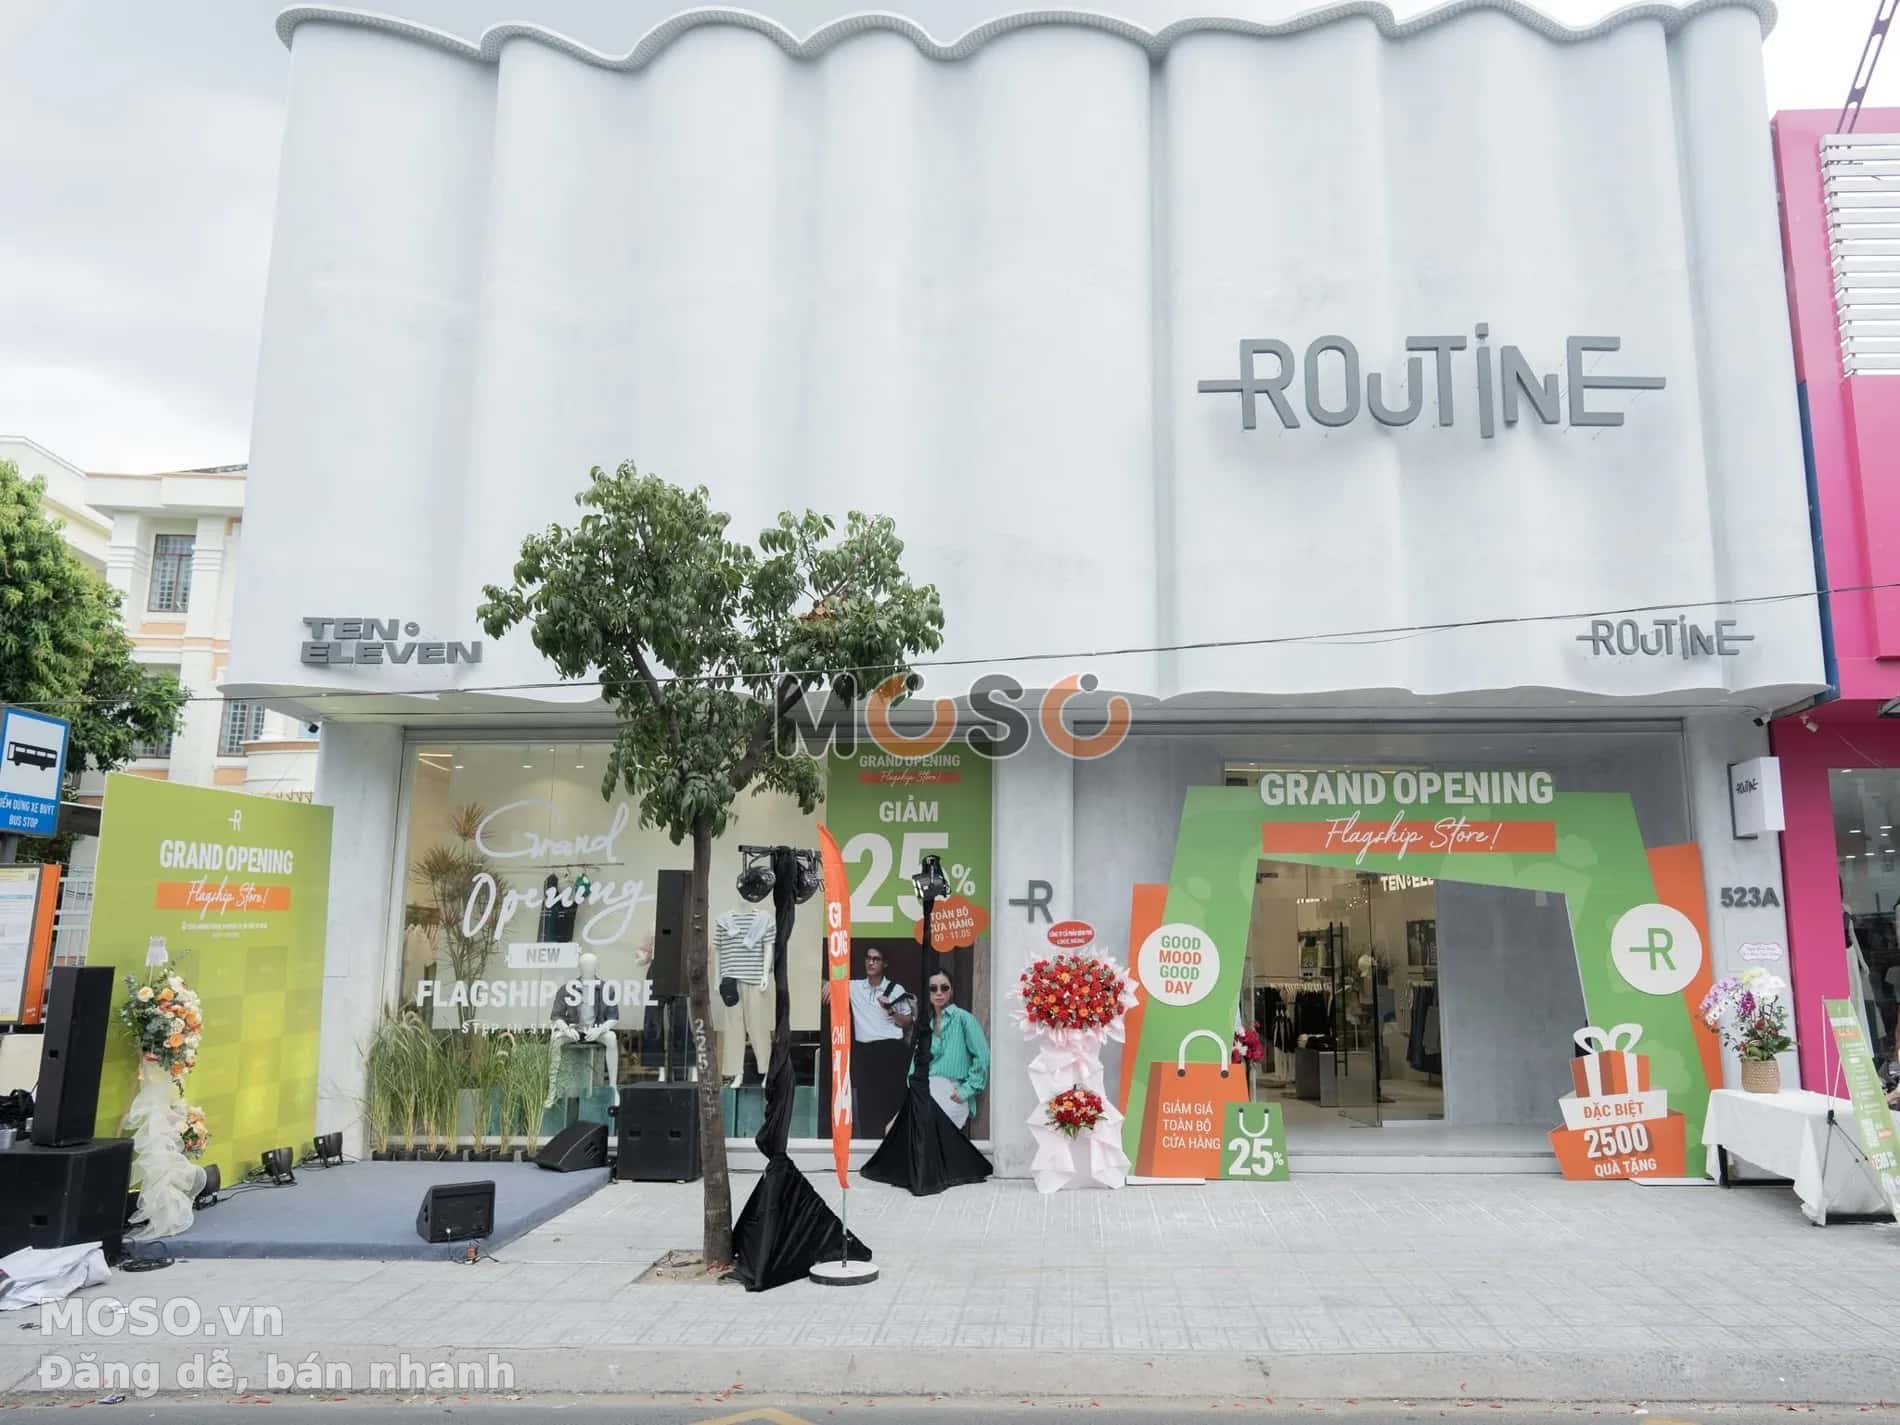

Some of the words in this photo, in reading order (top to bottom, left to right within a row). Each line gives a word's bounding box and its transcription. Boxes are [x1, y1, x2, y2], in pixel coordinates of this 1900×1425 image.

[301, 641, 482, 664] ELEVEN
[860, 755, 903, 768] GRAND
[905, 753, 960, 768] OPENING
[1260, 772, 1386, 806] GRAND
[1393, 771, 1554, 805] OPENING
[879, 795, 939, 823] GIẢM
[9, 814, 21, 827] BUS
[22, 816, 39, 828] STOP
[475, 800, 630, 863] Grand
[1326, 810, 1424, 865] Flagship
[160, 839, 223, 870] GRAND
[226, 844, 294, 875] OPENING
[462, 872, 656, 945] Opening
[1720, 886, 1781, 909] 523A
[1161, 935, 1201, 950] GOOD
[1630, 927, 1677, 971] R
[525, 948, 561, 964] NEW
[1159, 949, 1202, 965] MOOD
[1160, 965, 1200, 980] GOOD
[415, 979, 558, 1008] FLAGSHIP
[564, 979, 659, 1008] STORE
[1165, 980, 1193, 995] DAY
[461, 1022, 500, 1035] STEP
[1162, 1099, 1192, 1115] GIẢM
[1194, 1099, 1213, 1114] GIÁ
[1583, 1102, 1611, 1121] ĐẶC
[1614, 1099, 1644, 1118] BIỆT
[1163, 1117, 1192, 1132] TOÀN
[1196, 1118, 1212, 1134] BỘ
[1162, 1133, 1186, 1149] CỬA
[1188, 1135, 1221, 1150] HÀNG
[1583, 1122, 1649, 1159] 2500
[1228, 1137, 1285, 1177] 25%
[1594, 1159, 1621, 1178] QUÀ
[1622, 1157, 1657, 1176] TẶNG
